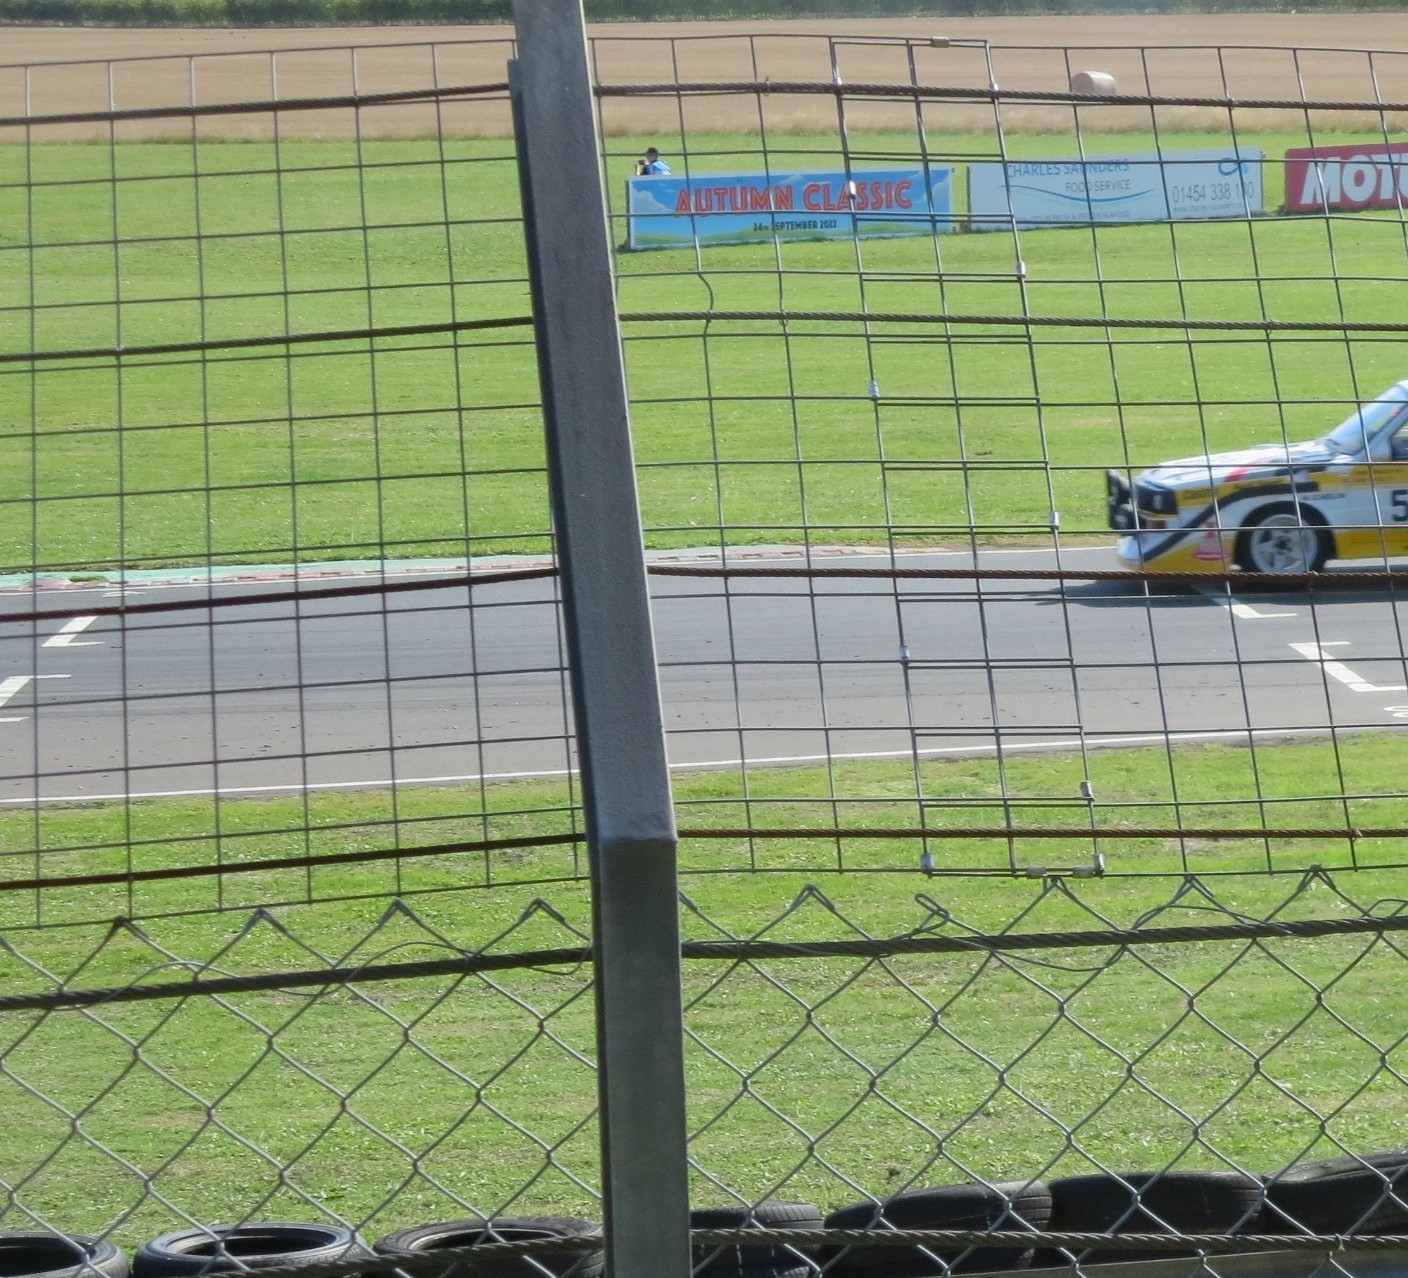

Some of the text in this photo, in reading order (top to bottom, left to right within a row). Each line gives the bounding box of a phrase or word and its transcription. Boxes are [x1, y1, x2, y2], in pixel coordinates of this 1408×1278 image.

[1007, 162, 1060, 178] CHARLES
[1094, 179, 1131, 192] SERVICE
[675, 180, 913, 217] AUTUMN CLASSIC
